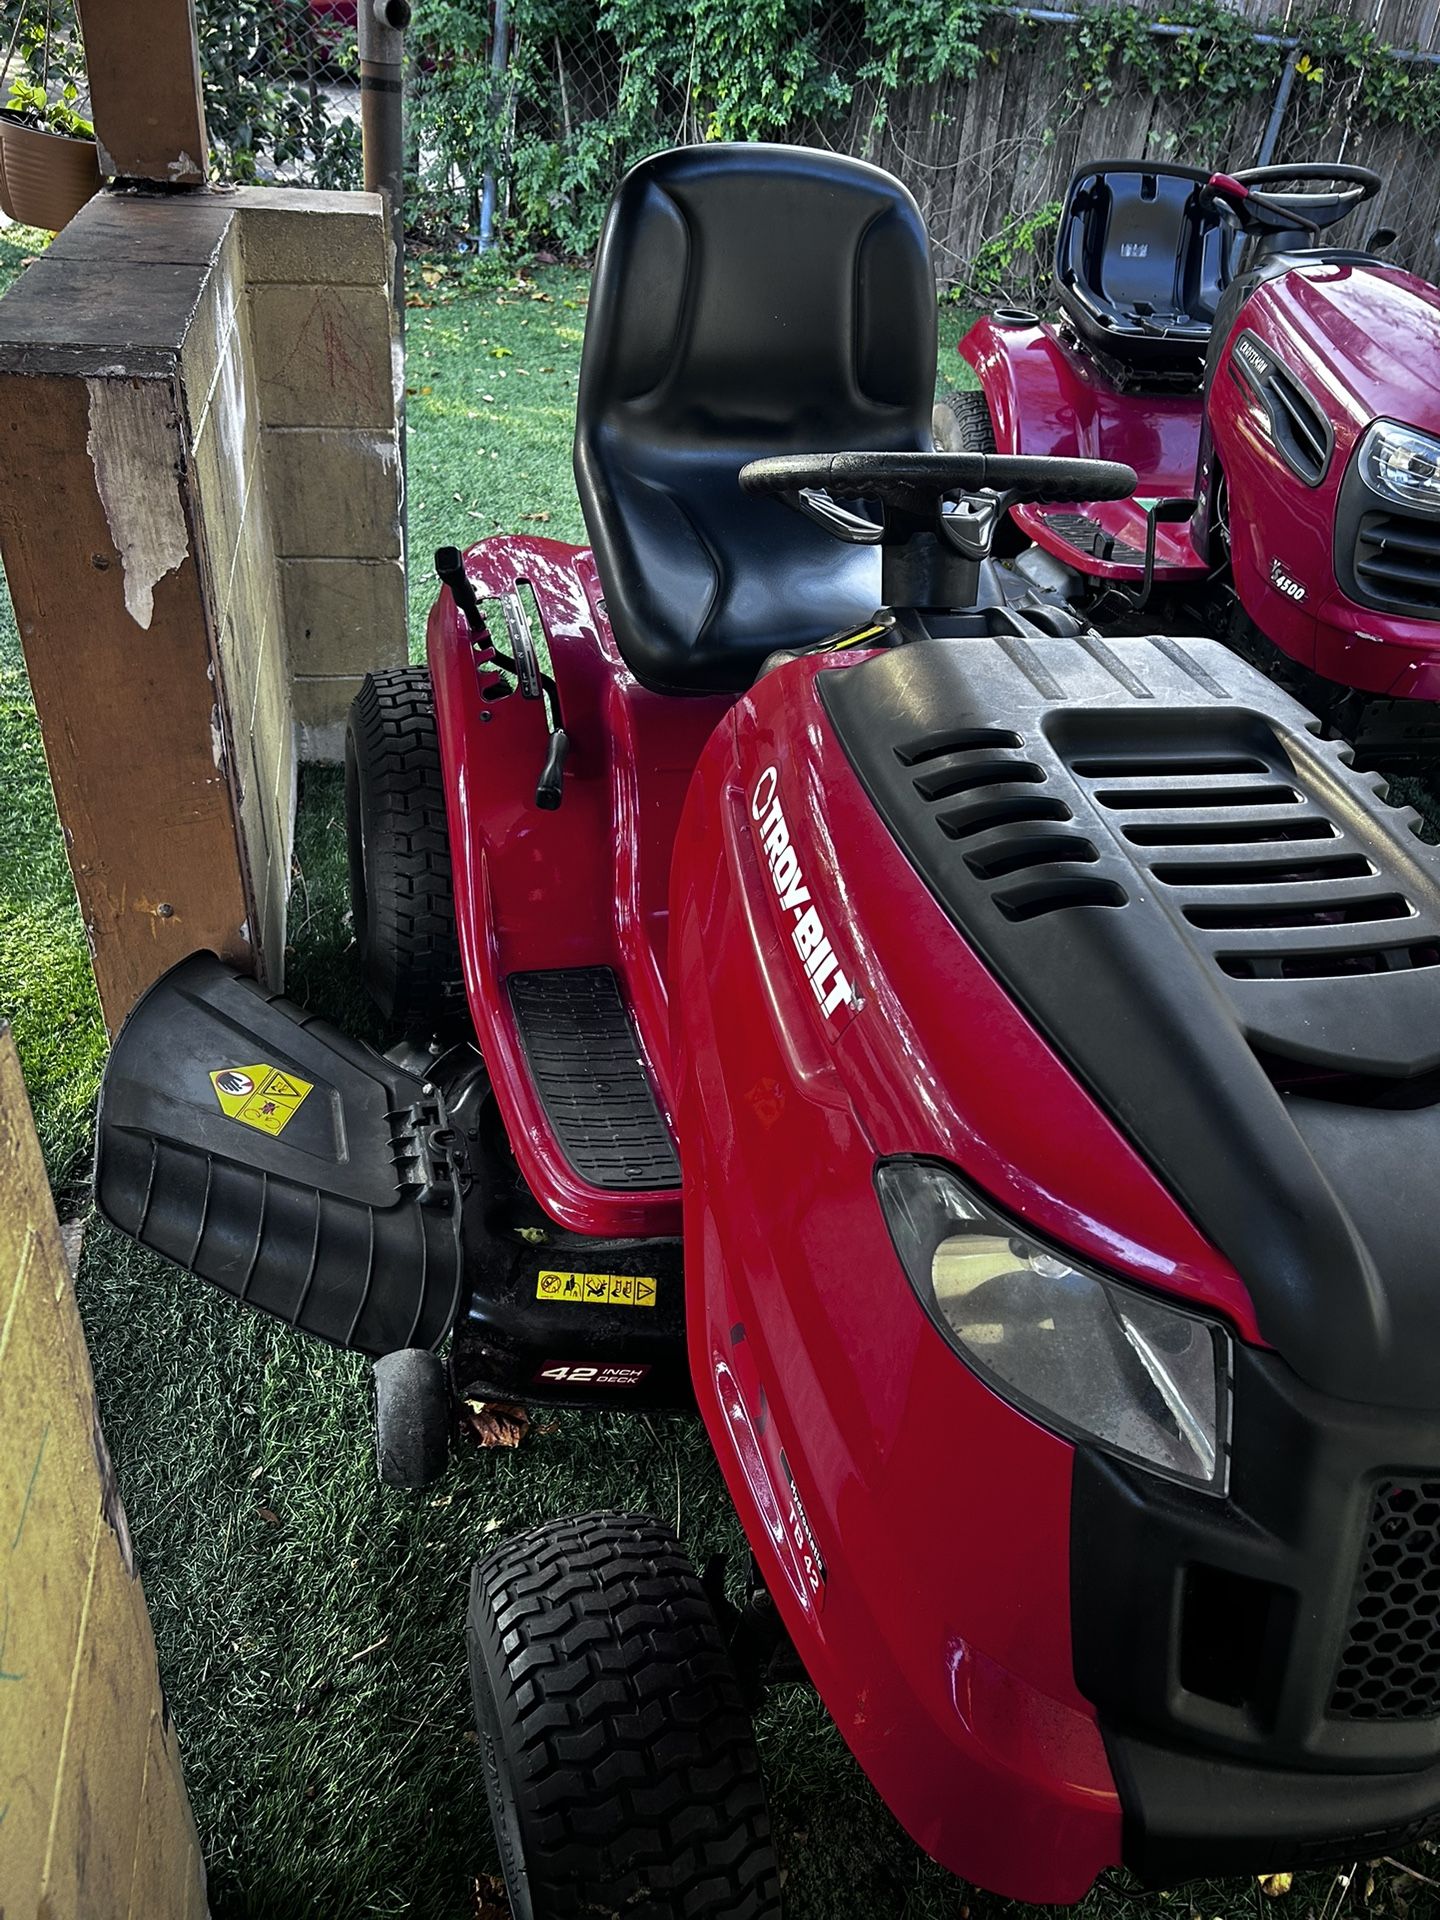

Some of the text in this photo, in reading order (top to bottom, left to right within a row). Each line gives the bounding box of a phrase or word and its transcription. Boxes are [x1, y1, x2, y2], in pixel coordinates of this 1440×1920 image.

[1239, 341, 1268, 374] CRAFTSMAN
[1275, 575, 1306, 600] 4500
[757, 795, 853, 1020] TROY-BILT
[541, 1366, 643, 1382] 42 INCH
[596, 1376, 639, 1384] DECK
[790, 1480, 823, 1571] Hydrostatic
[789, 1501, 819, 1594] TB 42
